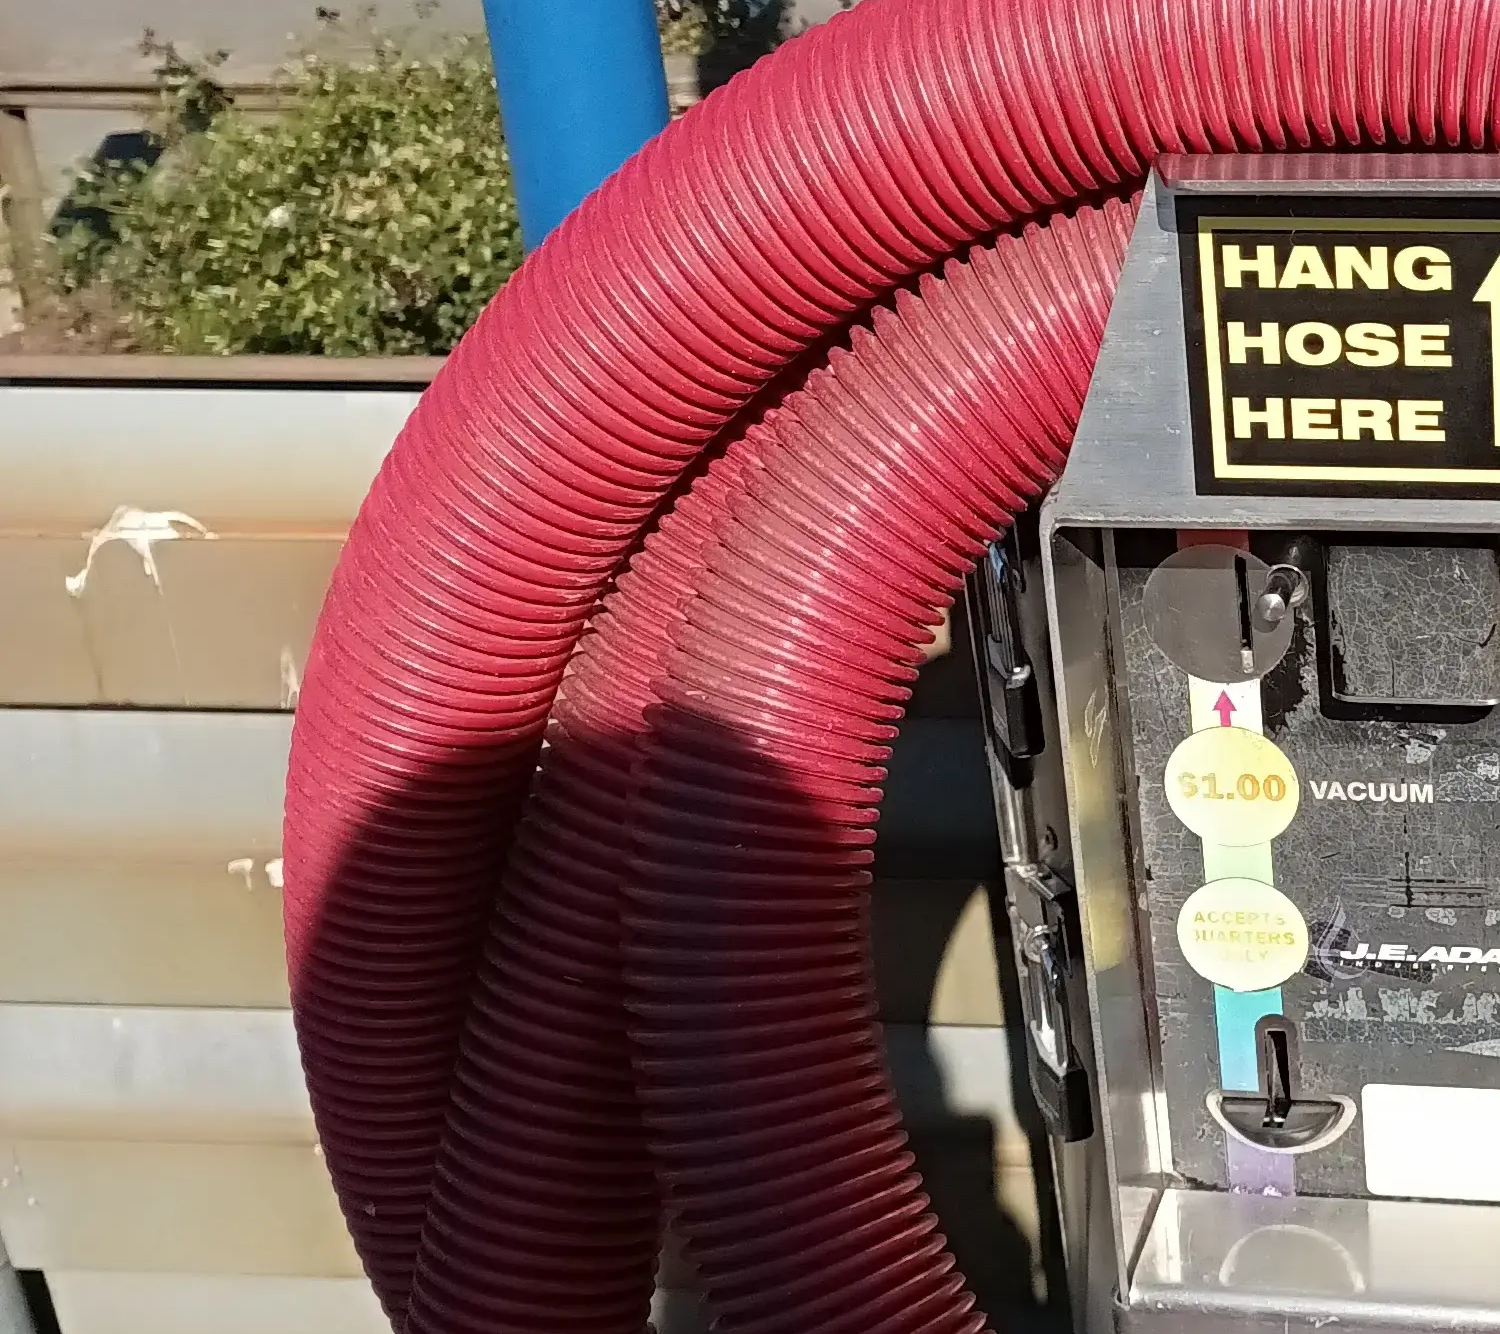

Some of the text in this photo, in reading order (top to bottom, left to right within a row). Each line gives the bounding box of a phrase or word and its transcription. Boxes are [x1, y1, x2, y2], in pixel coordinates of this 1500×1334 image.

[1221, 244, 1452, 291] HANG
[1227, 322, 1453, 367] HOSE
[1231, 396, 1446, 442] HERE
[1177, 771, 1288, 802] $1.00
[1309, 780, 1434, 804] VACUUM
[1194, 910, 1286, 926] ACCEPTS
